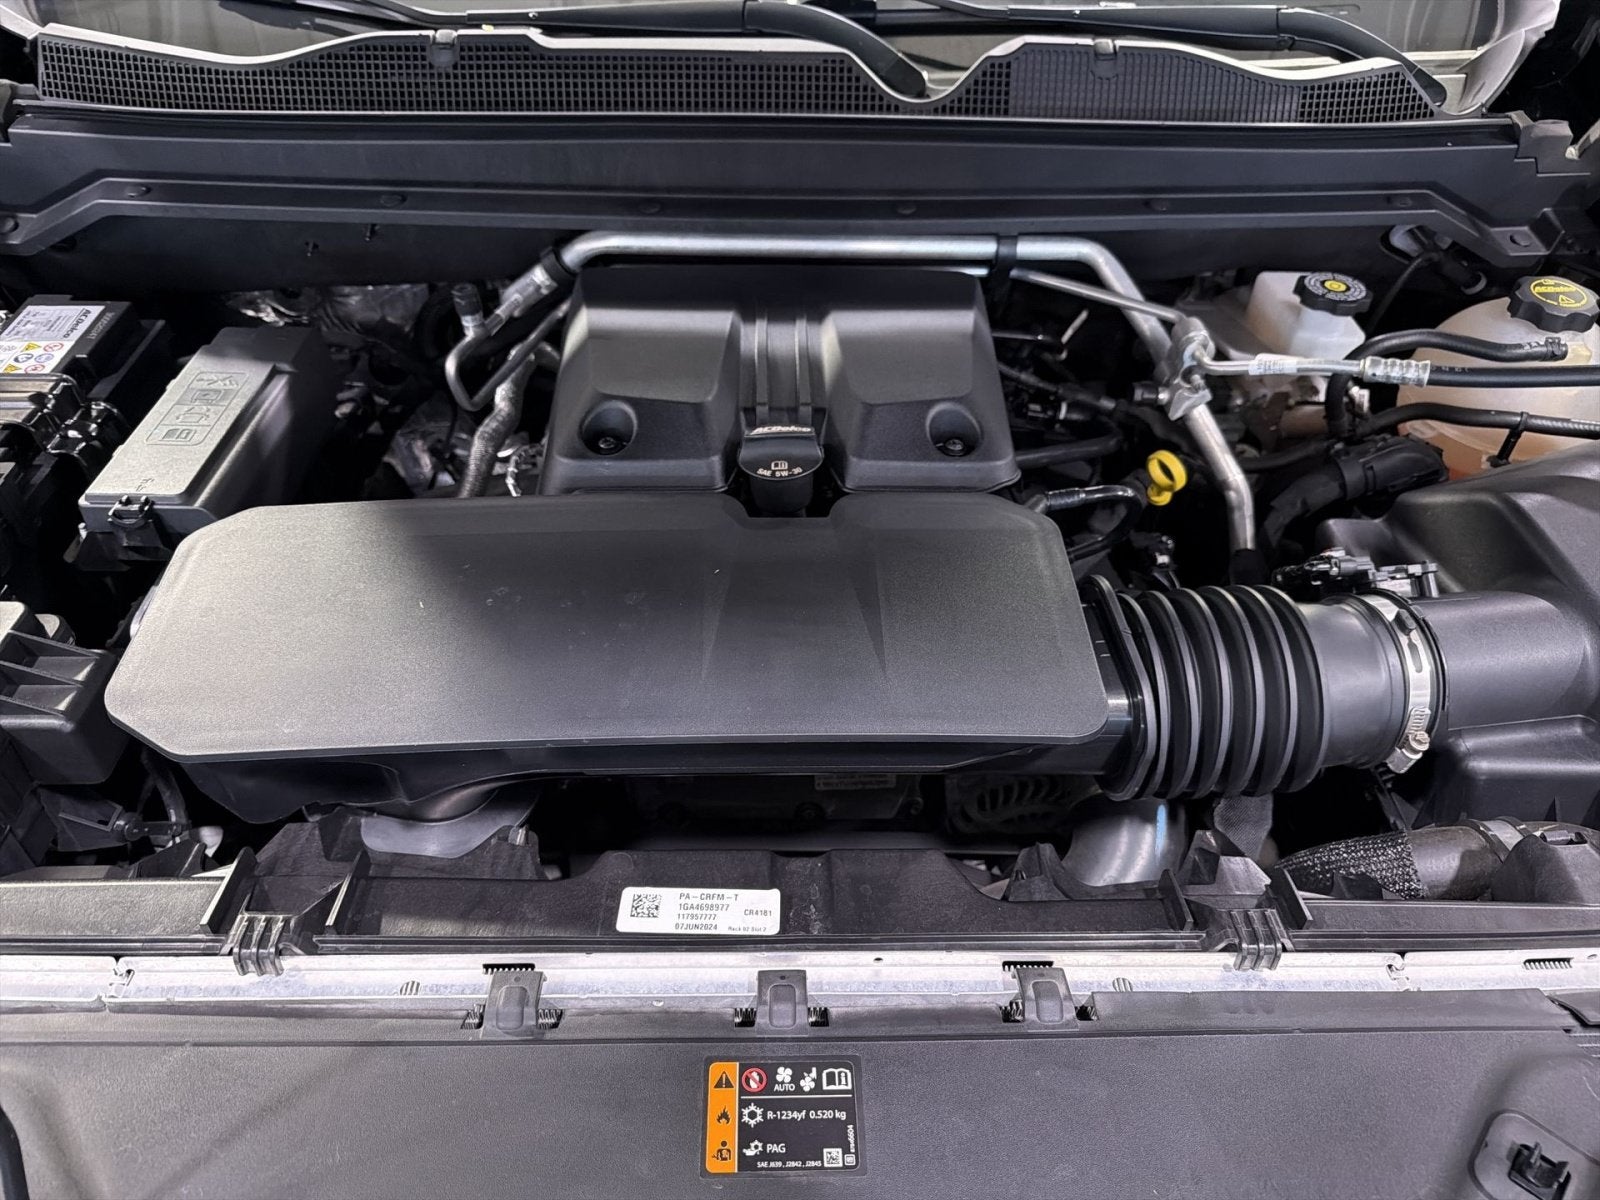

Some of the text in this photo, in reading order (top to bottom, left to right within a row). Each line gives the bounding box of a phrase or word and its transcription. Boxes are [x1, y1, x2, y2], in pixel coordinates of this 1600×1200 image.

[756, 466, 803, 477] SAE 5W-30
[679, 903, 730, 912] 1GA4698977
[677, 913, 717, 921] 117957777
[675, 923, 718, 931] 07JUN2024
[774, 1083, 795, 1091] AUTO
[767, 1110, 847, 1121] R-1234yf 0.520 kg
[766, 1143, 787, 1153] PAG
